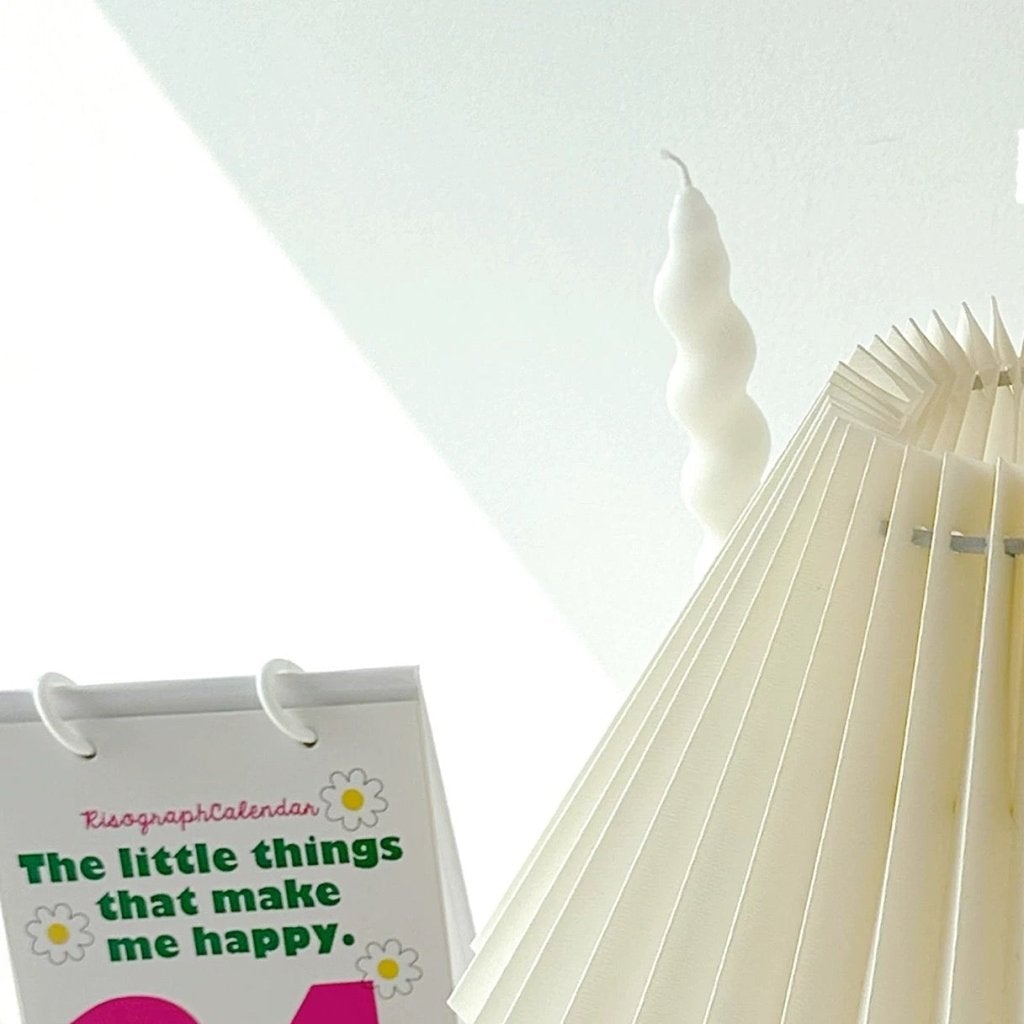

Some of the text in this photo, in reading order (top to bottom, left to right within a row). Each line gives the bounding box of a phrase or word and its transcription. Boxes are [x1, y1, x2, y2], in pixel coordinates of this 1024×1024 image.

[17, 835, 403, 885] The little things
[96, 878, 342, 921] that make
[106, 922, 356, 963] me happy.
